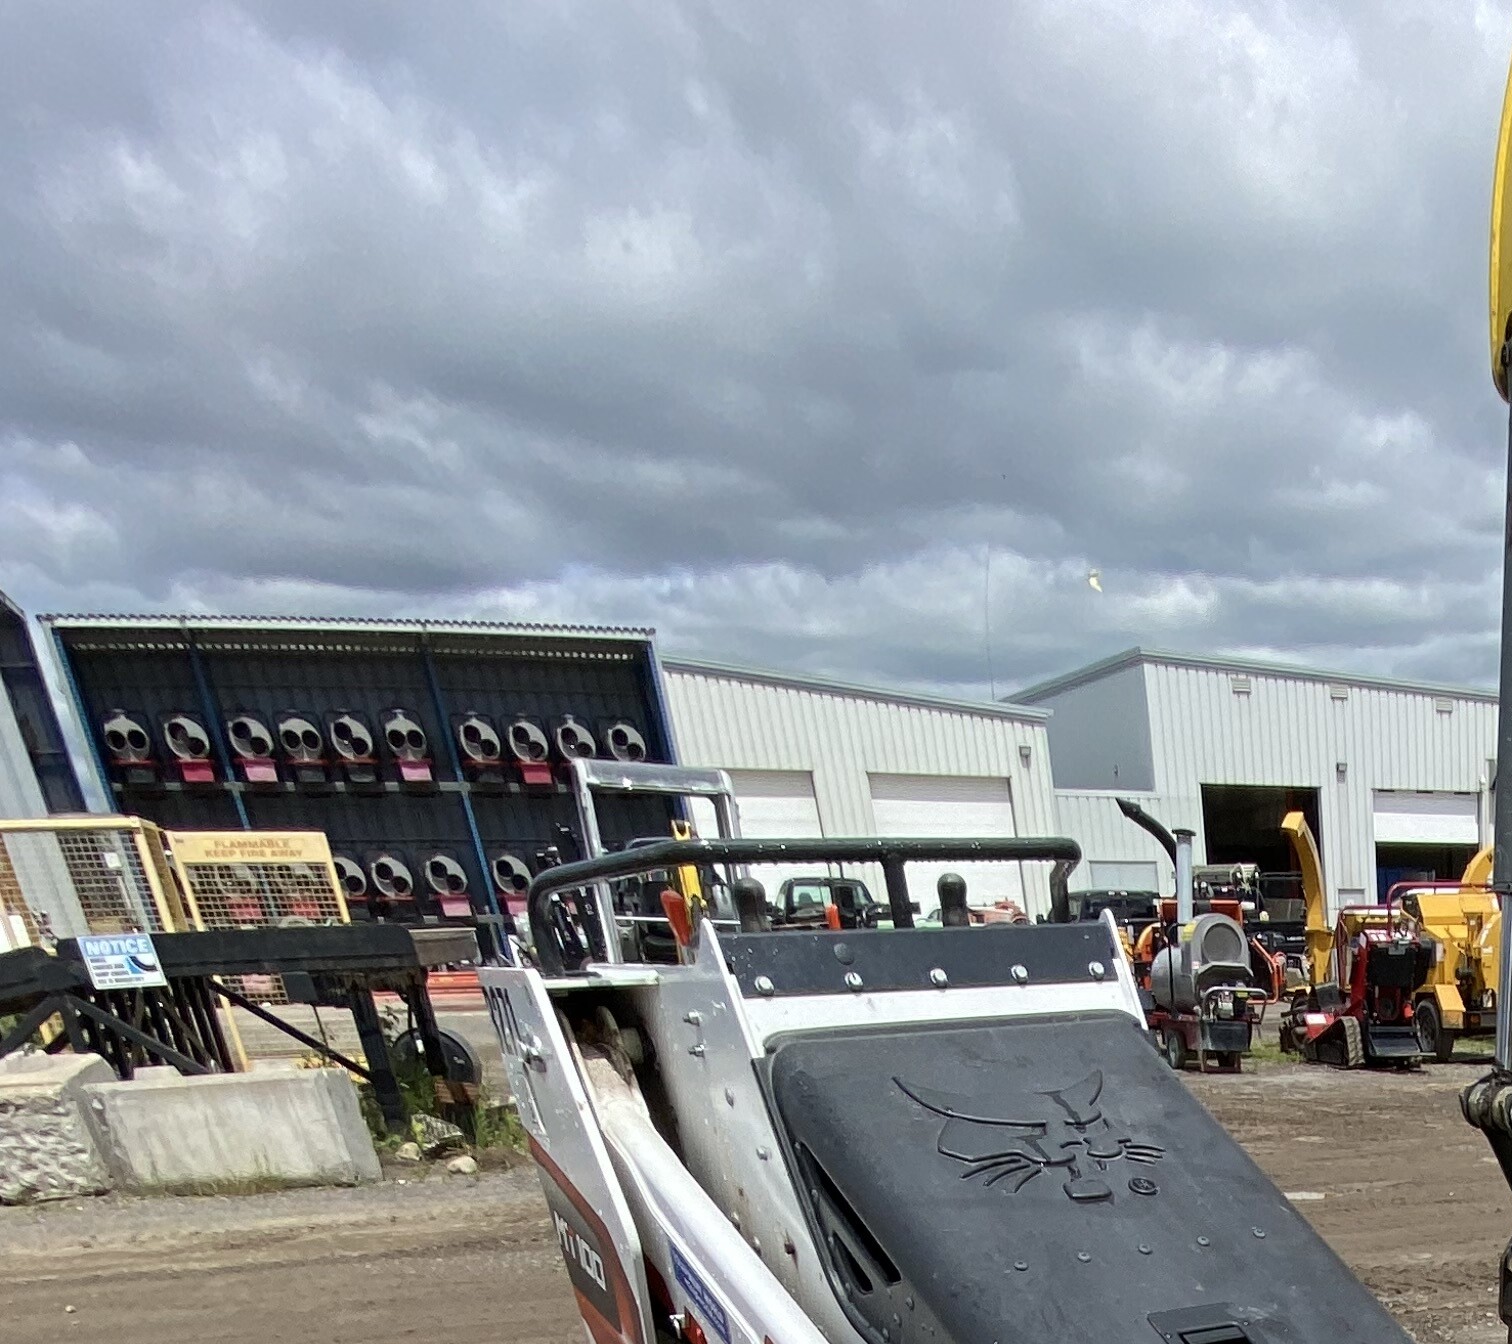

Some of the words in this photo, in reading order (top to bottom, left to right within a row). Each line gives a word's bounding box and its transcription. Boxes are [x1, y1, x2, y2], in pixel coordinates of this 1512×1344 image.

[213, 838, 291, 850] FLAMMABLE
[204, 850, 237, 859] KEEP
[240, 850, 268, 859] FIRE
[270, 850, 303, 859] AWAY
[84, 937, 149, 956] NOTICE
